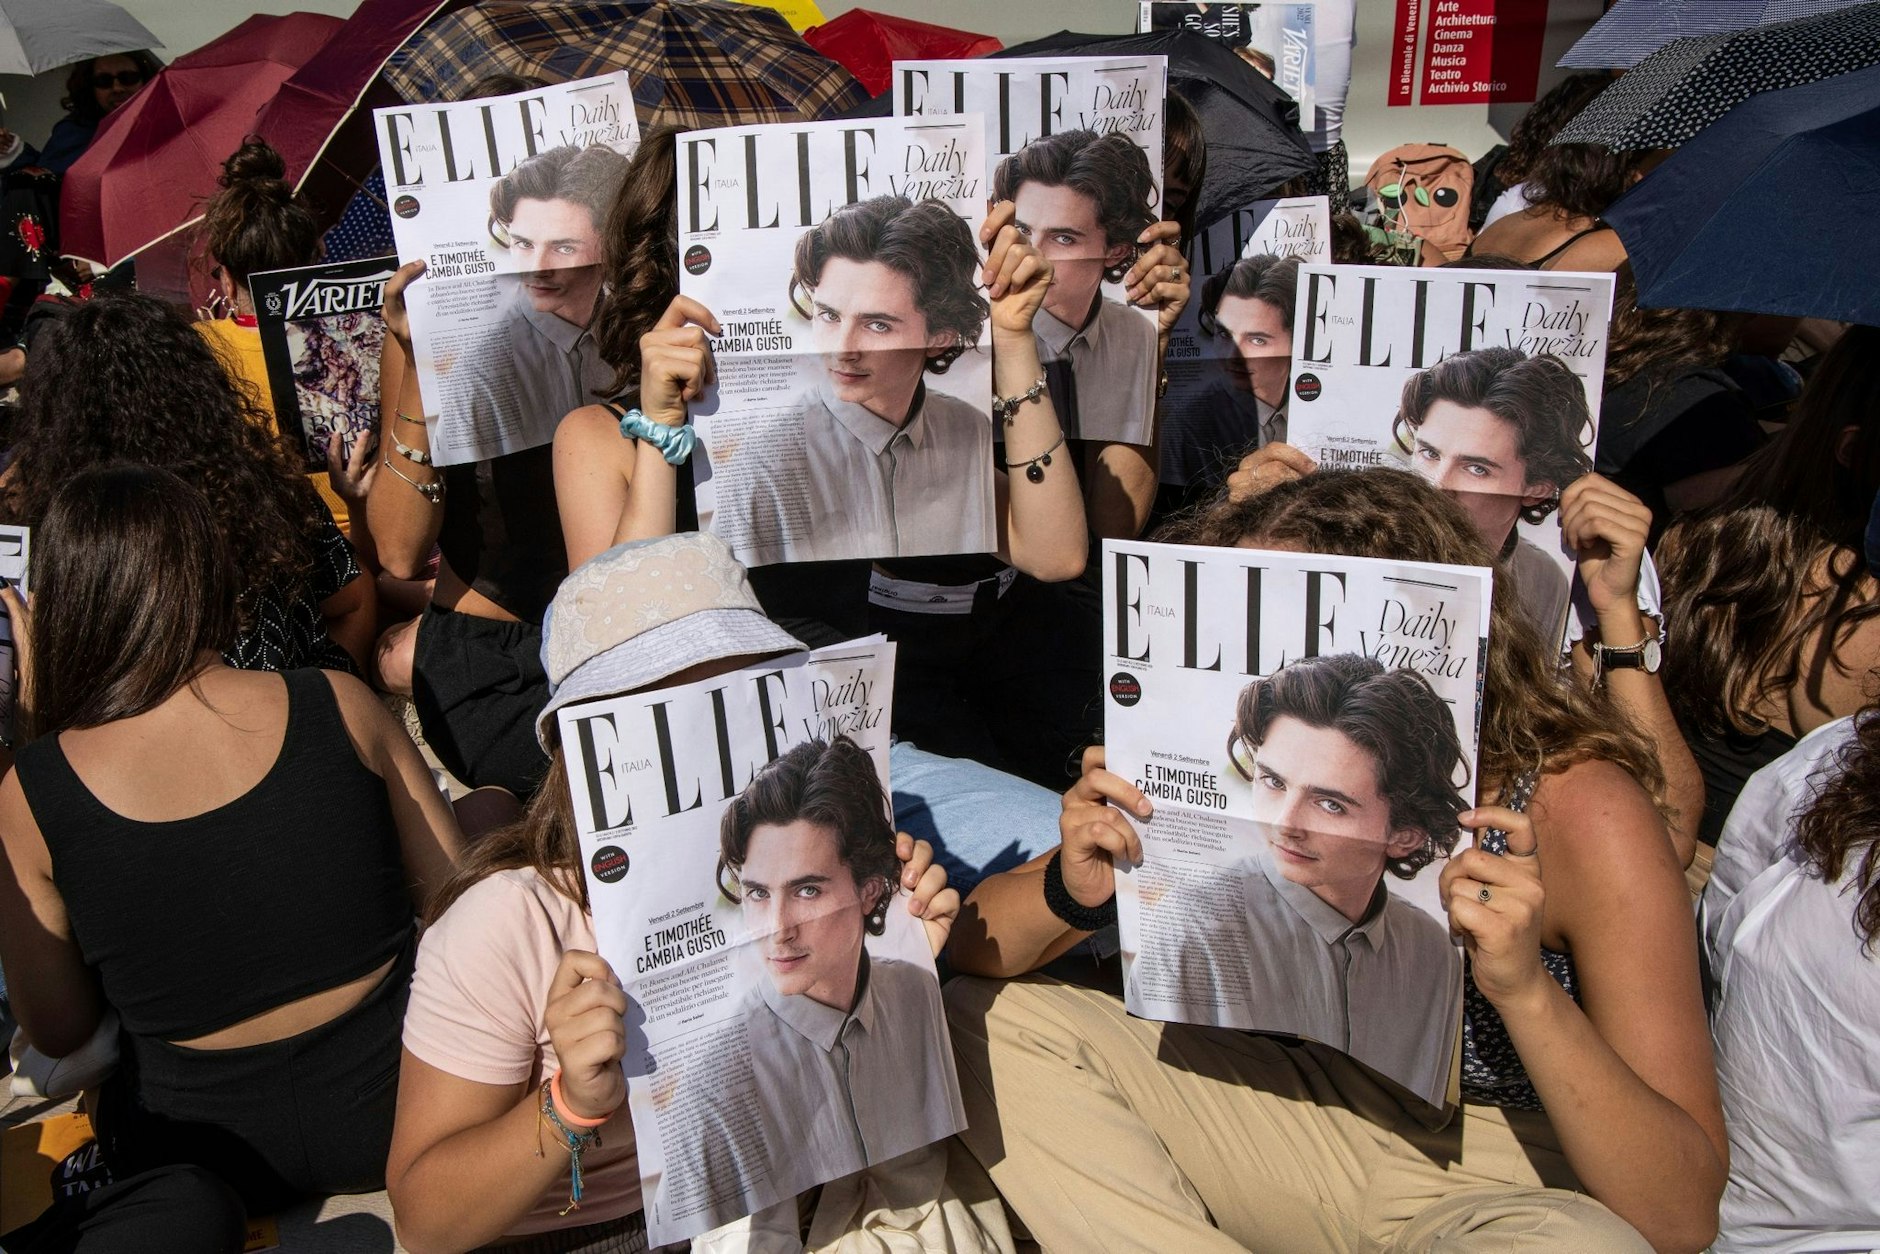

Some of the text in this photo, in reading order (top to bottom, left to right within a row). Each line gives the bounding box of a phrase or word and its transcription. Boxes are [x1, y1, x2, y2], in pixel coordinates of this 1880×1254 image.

[1436, 1, 1459, 12] Arte
[1435, 14, 1497, 26] Architettura
[1400, 0, 1418, 94] La Biennale di Venezi
[1434, 30, 1473, 40] Cinema
[1433, 43, 1464, 53] Danza
[1431, 56, 1466, 66] Musica
[1428, 81, 1506, 93] Archivio Storico
[1430, 69, 1461, 80] Teatro
[1093, 78, 1148, 114] Daily
[571, 94, 620, 128] Daily
[1079, 110, 1156, 133] Venezia
[380, 96, 547, 187] ELLE
[560, 122, 632, 148] Venezia
[904, 138, 967, 178] Daily
[682, 128, 876, 234] ELLE
[714, 178, 739, 188] ITALIA
[889, 174, 978, 200] Venezia
[1274, 214, 1317, 241] Daily
[431, 255, 437, 266] E
[439, 249, 486, 265] TIMOTHÉE
[426, 262, 496, 280] CAMBIA GUSTO
[280, 270, 397, 320] VARIET
[728, 318, 783, 337] TIMOTHÉE
[1298, 273, 1496, 368] ELLE
[1331, 316, 1355, 325] ITALIA
[1522, 300, 1590, 338] Daily
[710, 336, 792, 352] CAMBIA GUSTO
[1177, 347, 1200, 357] GUSTO
[1506, 328, 1598, 358] Venezia
[1321, 448, 1327, 460] E
[1330, 449, 1382, 465] TIMOTHÉE
[1109, 550, 1347, 677] ELLE
[1147, 605, 1176, 618] ITALIA
[1378, 599, 1458, 649] Daily
[1358, 630, 1468, 679] Venezia
[812, 668, 873, 712] Daily
[803, 706, 883, 742] Venezia
[568, 670, 788, 834] ELLE
[1178, 756, 1210, 766] Settembre
[621, 758, 653, 774] ITALIA
[1145, 764, 1152, 779] E
[1156, 766, 1217, 791] TIMOTHÉE
[1136, 780, 1227, 810] CAMBIA GUSTO
[593, 855, 627, 873] ENGLISH
[600, 851, 615, 861] WITH
[600, 865, 626, 878] VERSION
[648, 910, 670, 924] Venerdì
[676, 901, 704, 916] Settembre
[655, 913, 713, 948] TIMOTHÉE
[636, 929, 726, 973] CAMBIA GUSTO
[644, 935, 653, 952] E
[639, 956, 728, 991] In Bones and All, Chalamet
[641, 965, 728, 998] abbandona buone maniere
[642, 994, 670, 1008] camicie
[671, 987, 691, 1000] stirate
[691, 983, 703, 995] per
[704, 972, 734, 989] inseguire
[651, 985, 724, 1013] l'irresistibile richiamo
[648, 1015, 655, 1024] di
[656, 1013, 666, 1022] un
[666, 1003, 698, 1019] sodalizio
[699, 992, 729, 1007] cannibale
